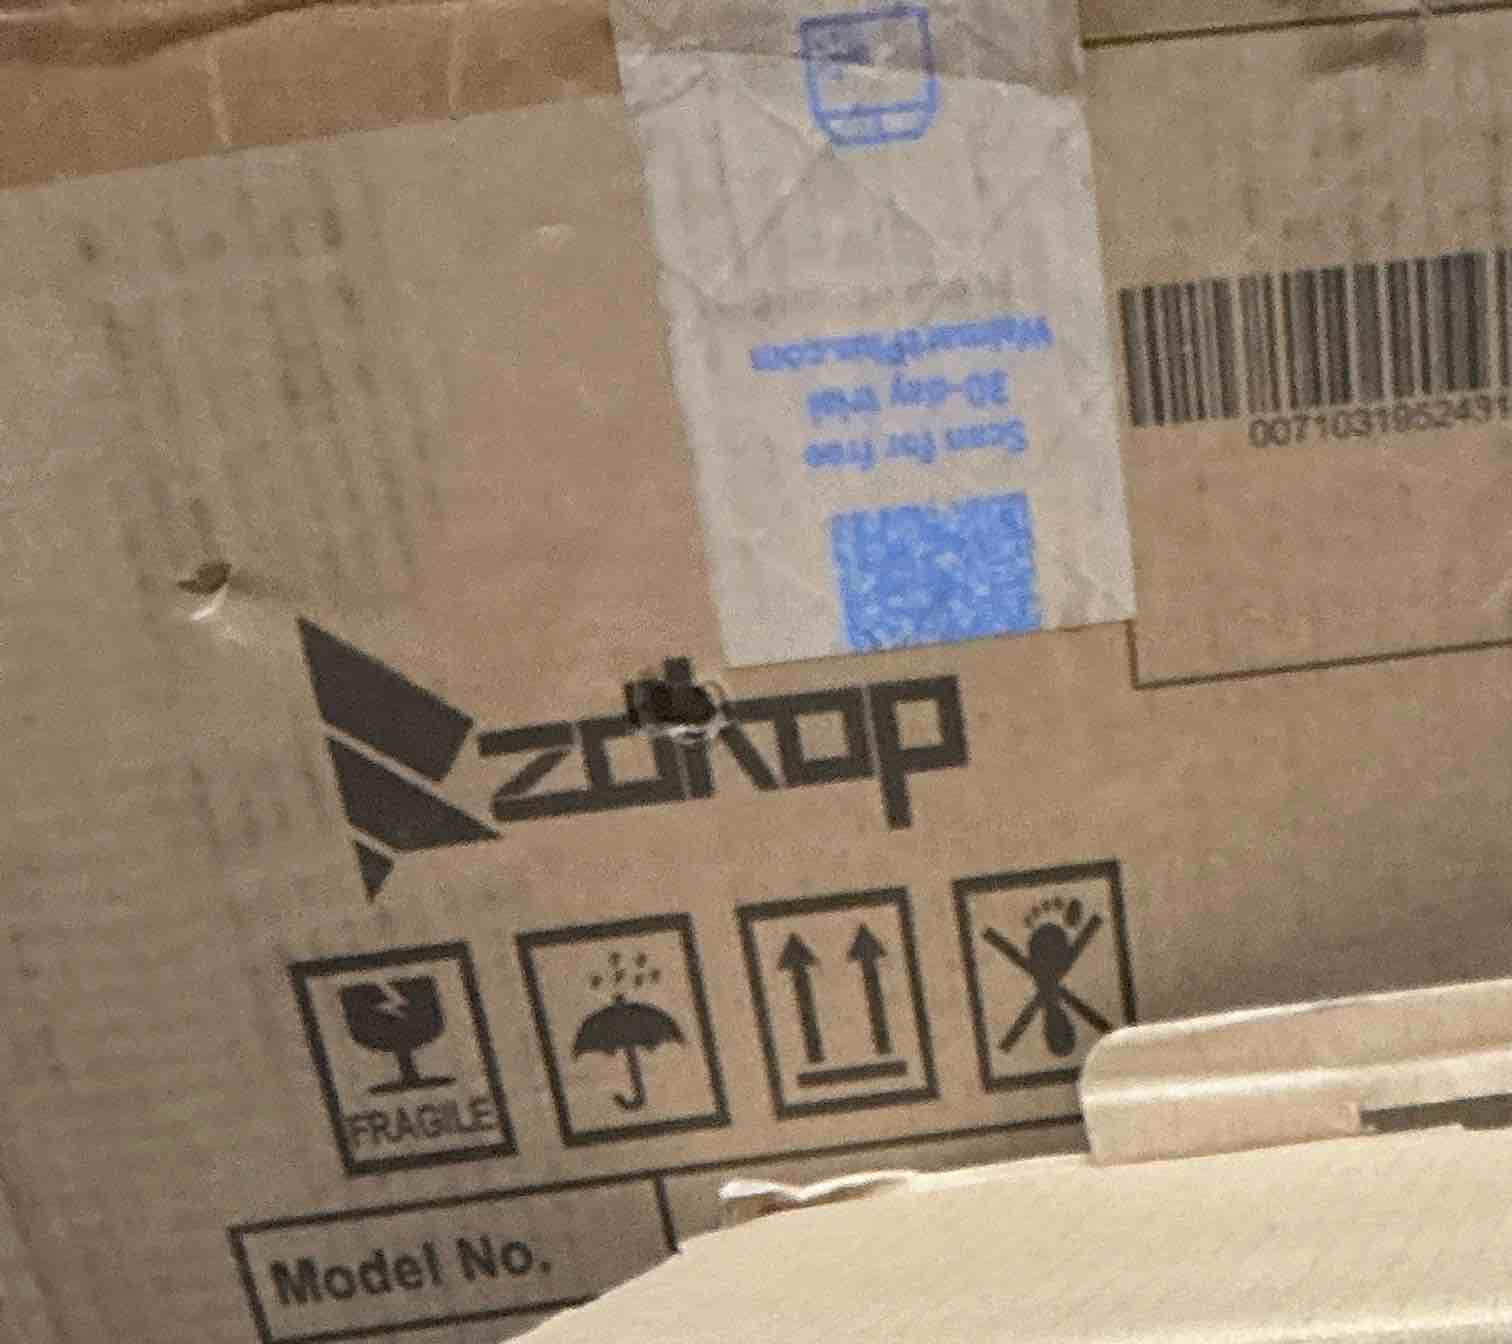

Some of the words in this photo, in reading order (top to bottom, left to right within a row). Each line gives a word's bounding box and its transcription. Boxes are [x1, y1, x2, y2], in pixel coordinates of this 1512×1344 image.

[347, 1096, 497, 1148] FRAGILE
[269, 1240, 443, 1304] Model
[456, 1234, 551, 1281] No.
